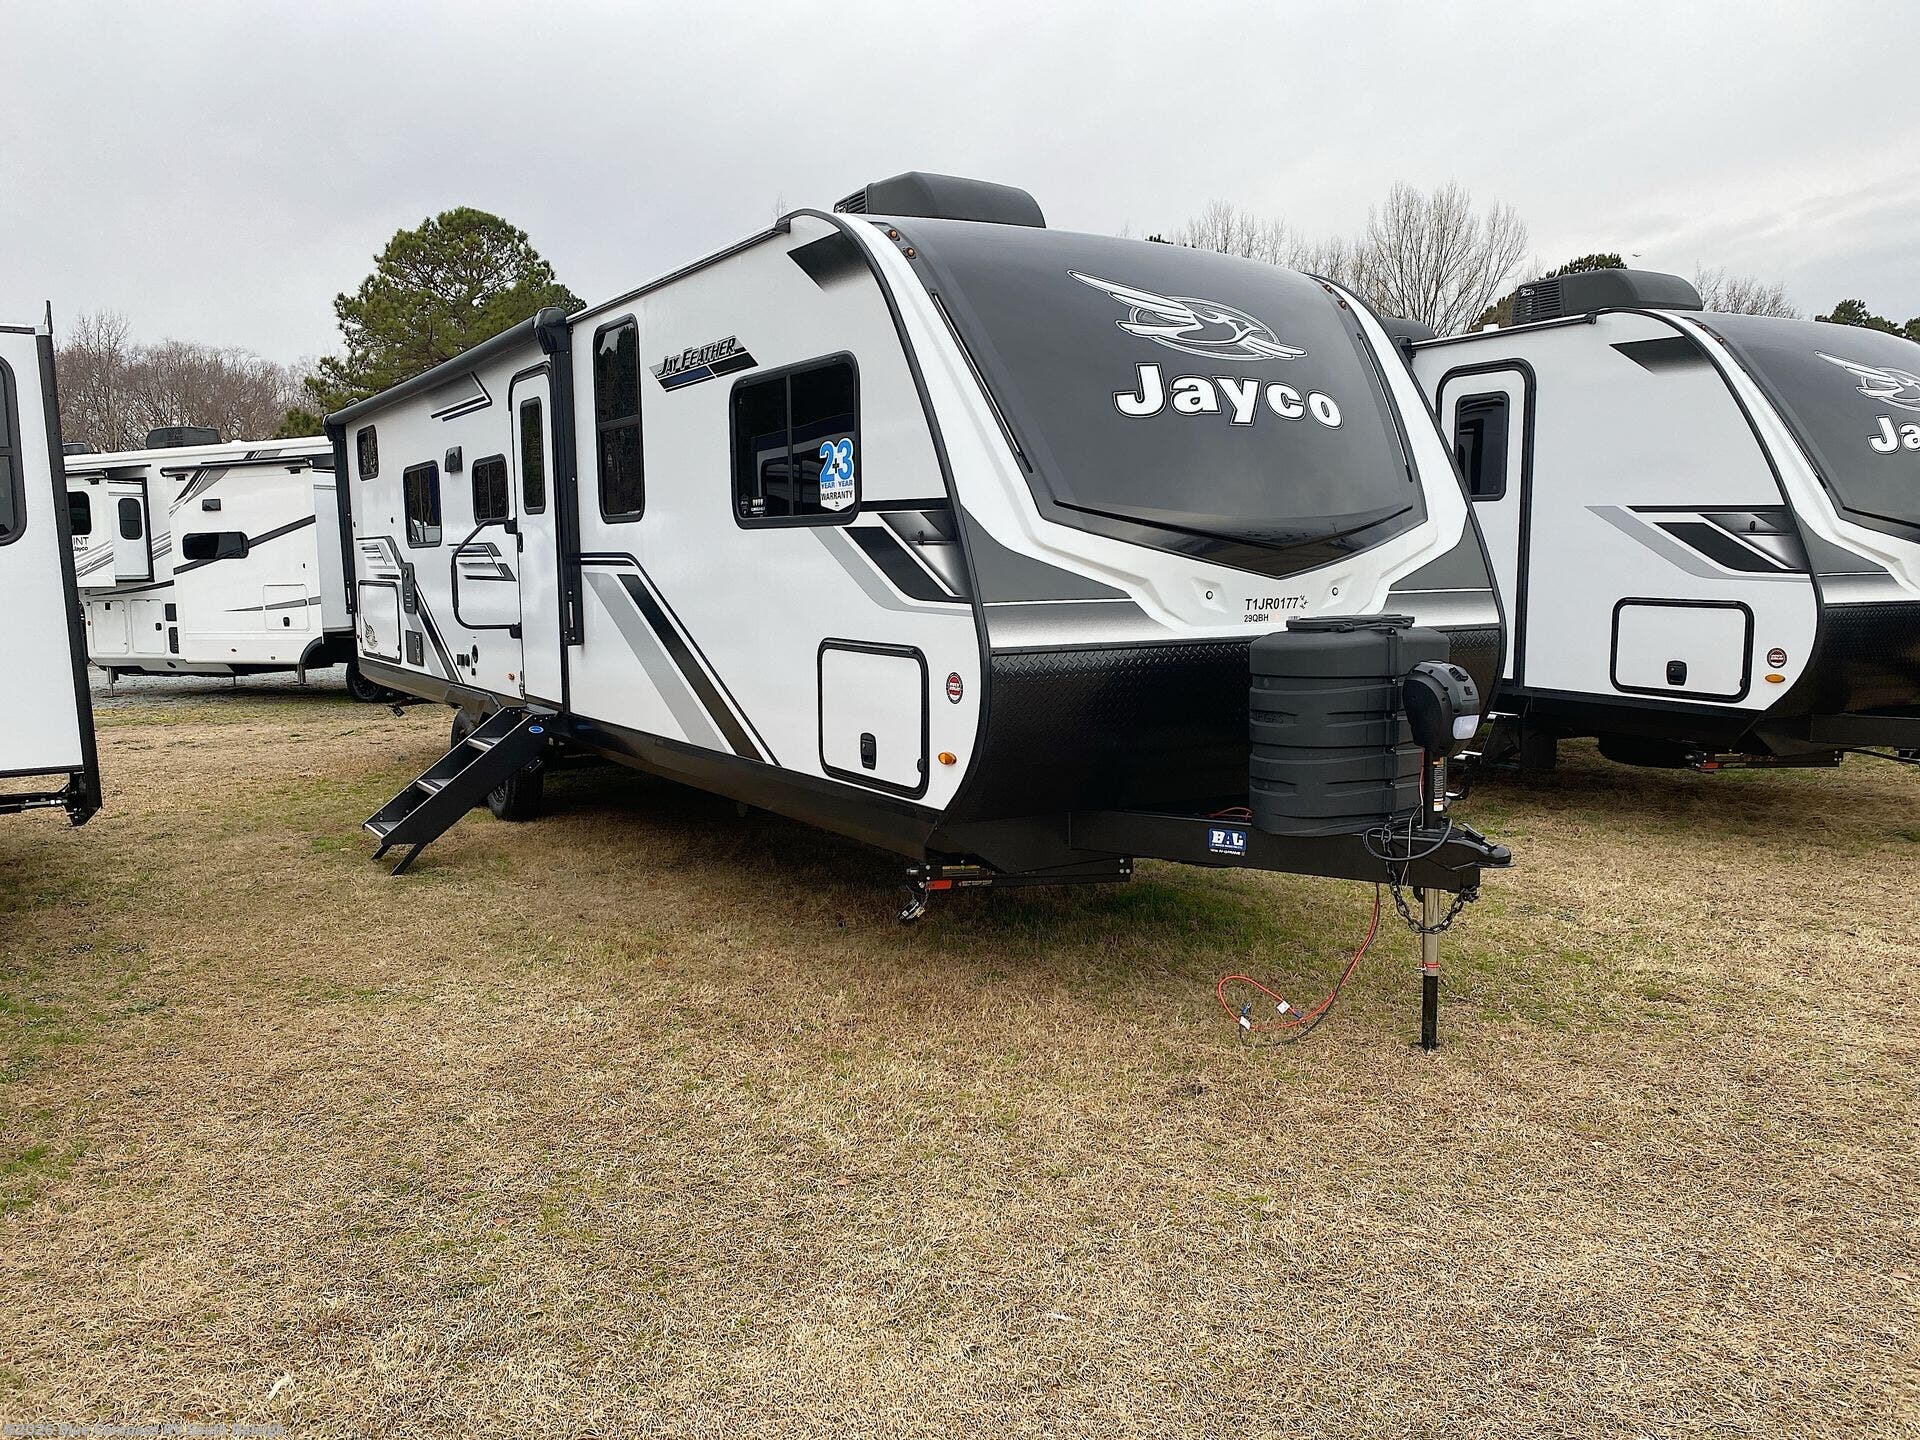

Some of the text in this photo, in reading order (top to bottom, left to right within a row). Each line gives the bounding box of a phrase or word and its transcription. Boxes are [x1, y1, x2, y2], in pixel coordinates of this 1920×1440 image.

[1113, 363, 1343, 429] Jayco
[821, 482, 835, 490] YEAR
[821, 490, 854, 500] WARRANTY
[1245, 597, 1299, 610] T1JR0177
[1244, 614, 1269, 622] 29QBH
